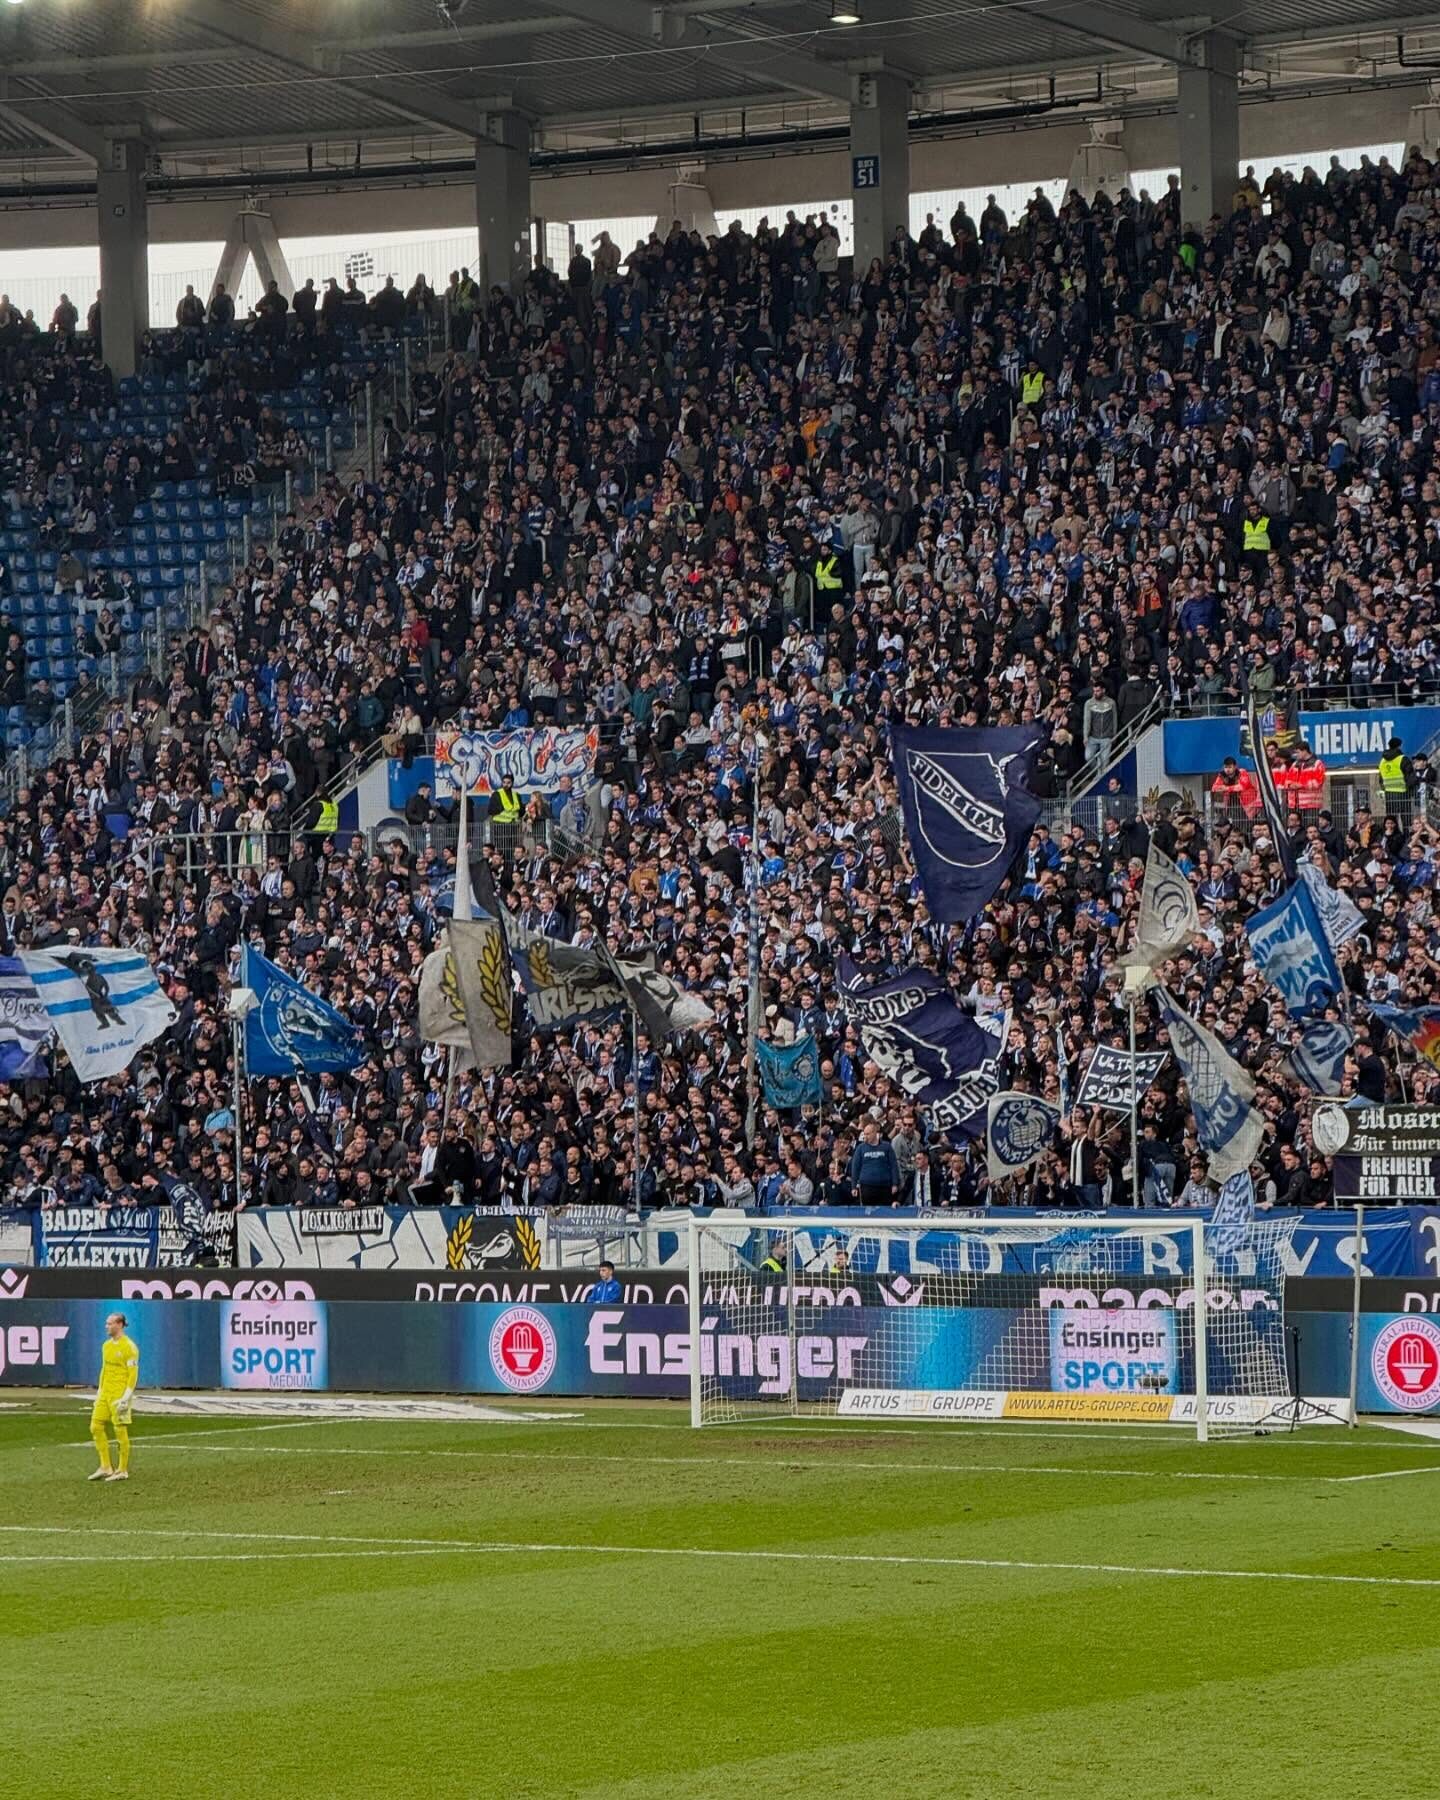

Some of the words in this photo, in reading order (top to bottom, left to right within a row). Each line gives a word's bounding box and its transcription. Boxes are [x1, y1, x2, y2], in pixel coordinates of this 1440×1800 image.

[858, 168, 874, 186] 51
[1315, 721, 1394, 755] HEIMAT
[911, 757, 1006, 838] FIDELITAS
[1362, 1156, 1433, 1176] FREIHEIT
[1396, 1176, 1436, 1196] ALEX
[42, 1208, 108, 1232] BADEN
[48, 1246, 151, 1269] KOLLEKTIV
[232, 1347, 316, 1375] SPORT
[269, 1374, 313, 1387] MEDIUM
[850, 1394, 901, 1410] ARTUS
[932, 1396, 995, 1411] GRUPPE
[1008, 1399, 1169, 1414] WWW.ARTUS-GRUPPE.COM
[1182, 1402, 1236, 1416] ATUS
